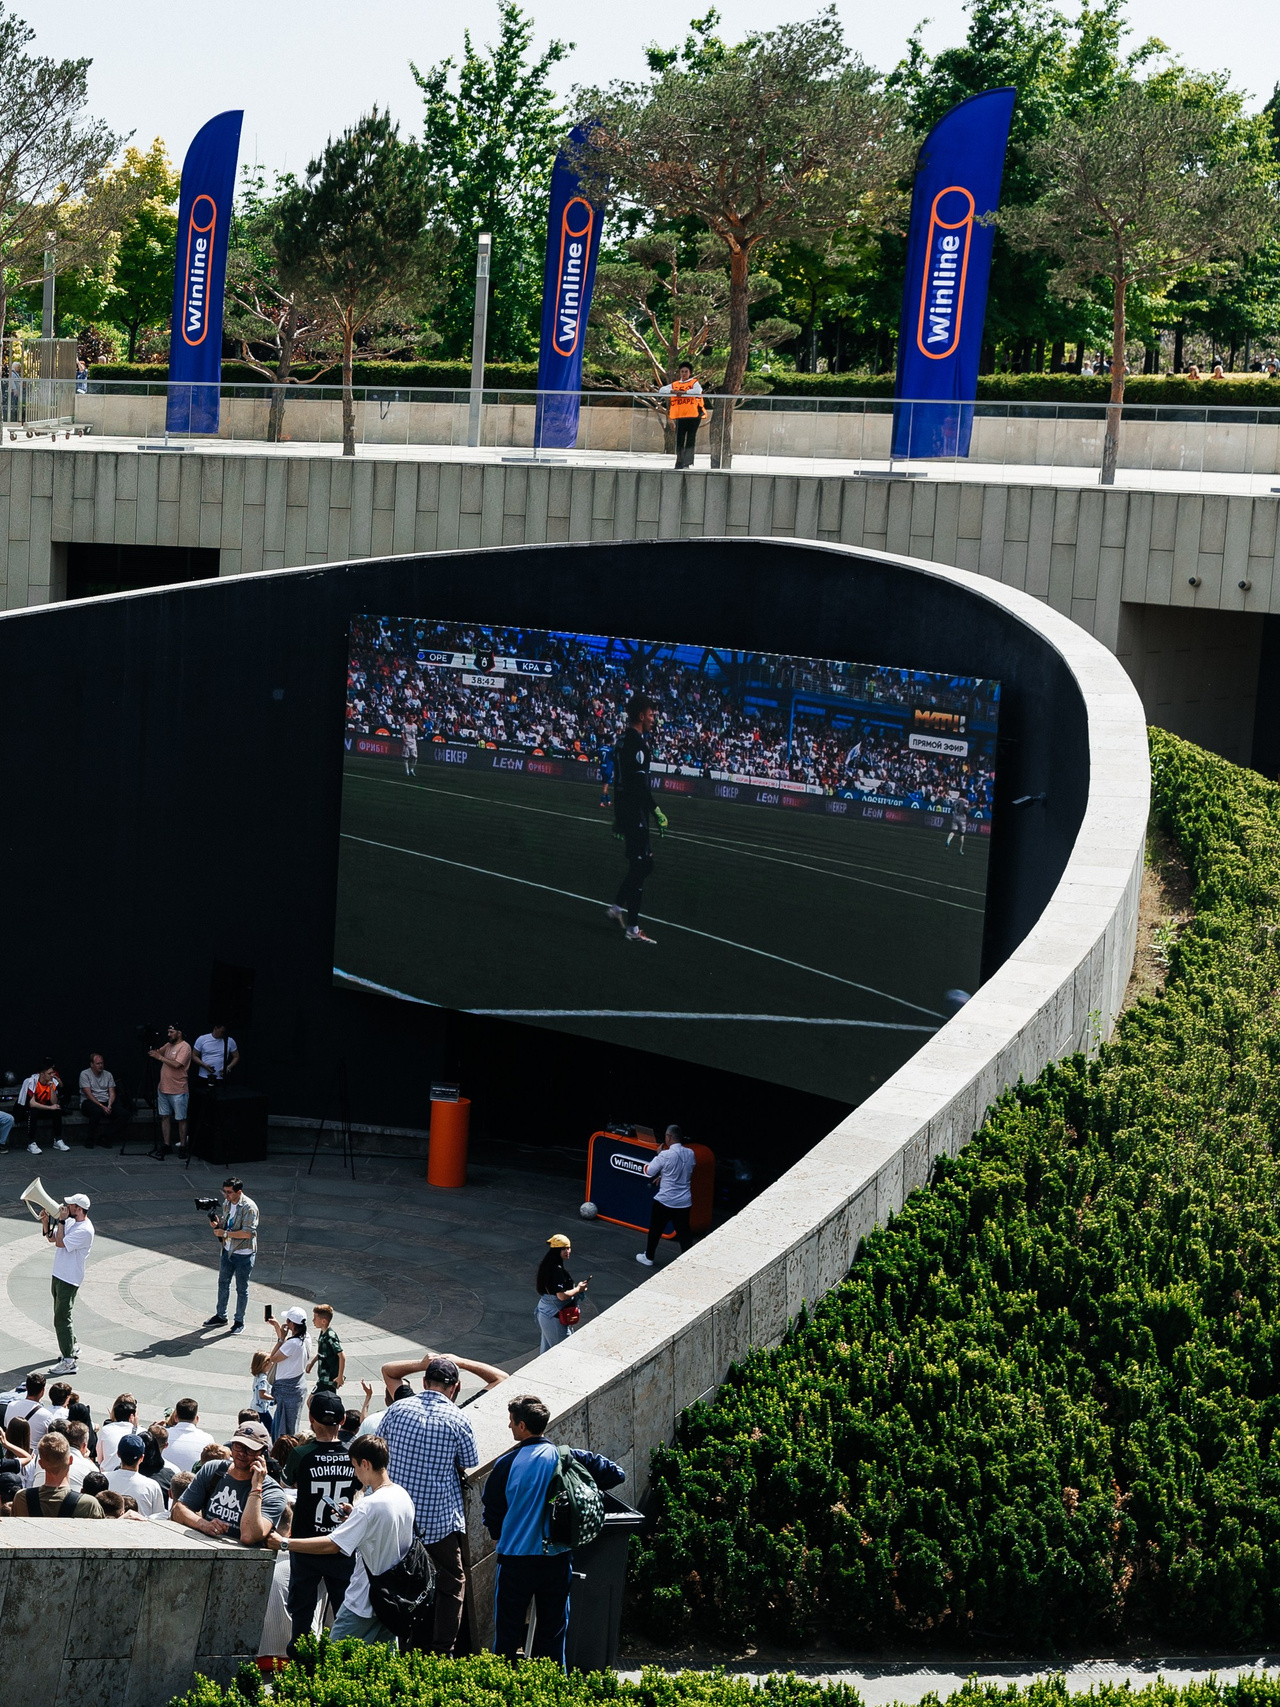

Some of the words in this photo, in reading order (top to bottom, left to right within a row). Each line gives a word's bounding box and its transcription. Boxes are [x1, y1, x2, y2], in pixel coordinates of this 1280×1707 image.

[187, 237, 207, 332] Winline
[559, 242, 583, 342] Winline
[927, 235, 960, 344] Winline
[461, 655, 467, 666] 1
[503, 659, 508, 670] 1
[522, 662, 540, 672] КРА
[471, 676, 496, 686] 38:42
[912, 738, 942, 750] ПРЯМОЙ
[943, 743, 965, 753] ЭФИР
[613, 1157, 643, 1172] Winline
[208, 1502, 240, 1522] Kappa
[310, 1480, 353, 1524] 75
